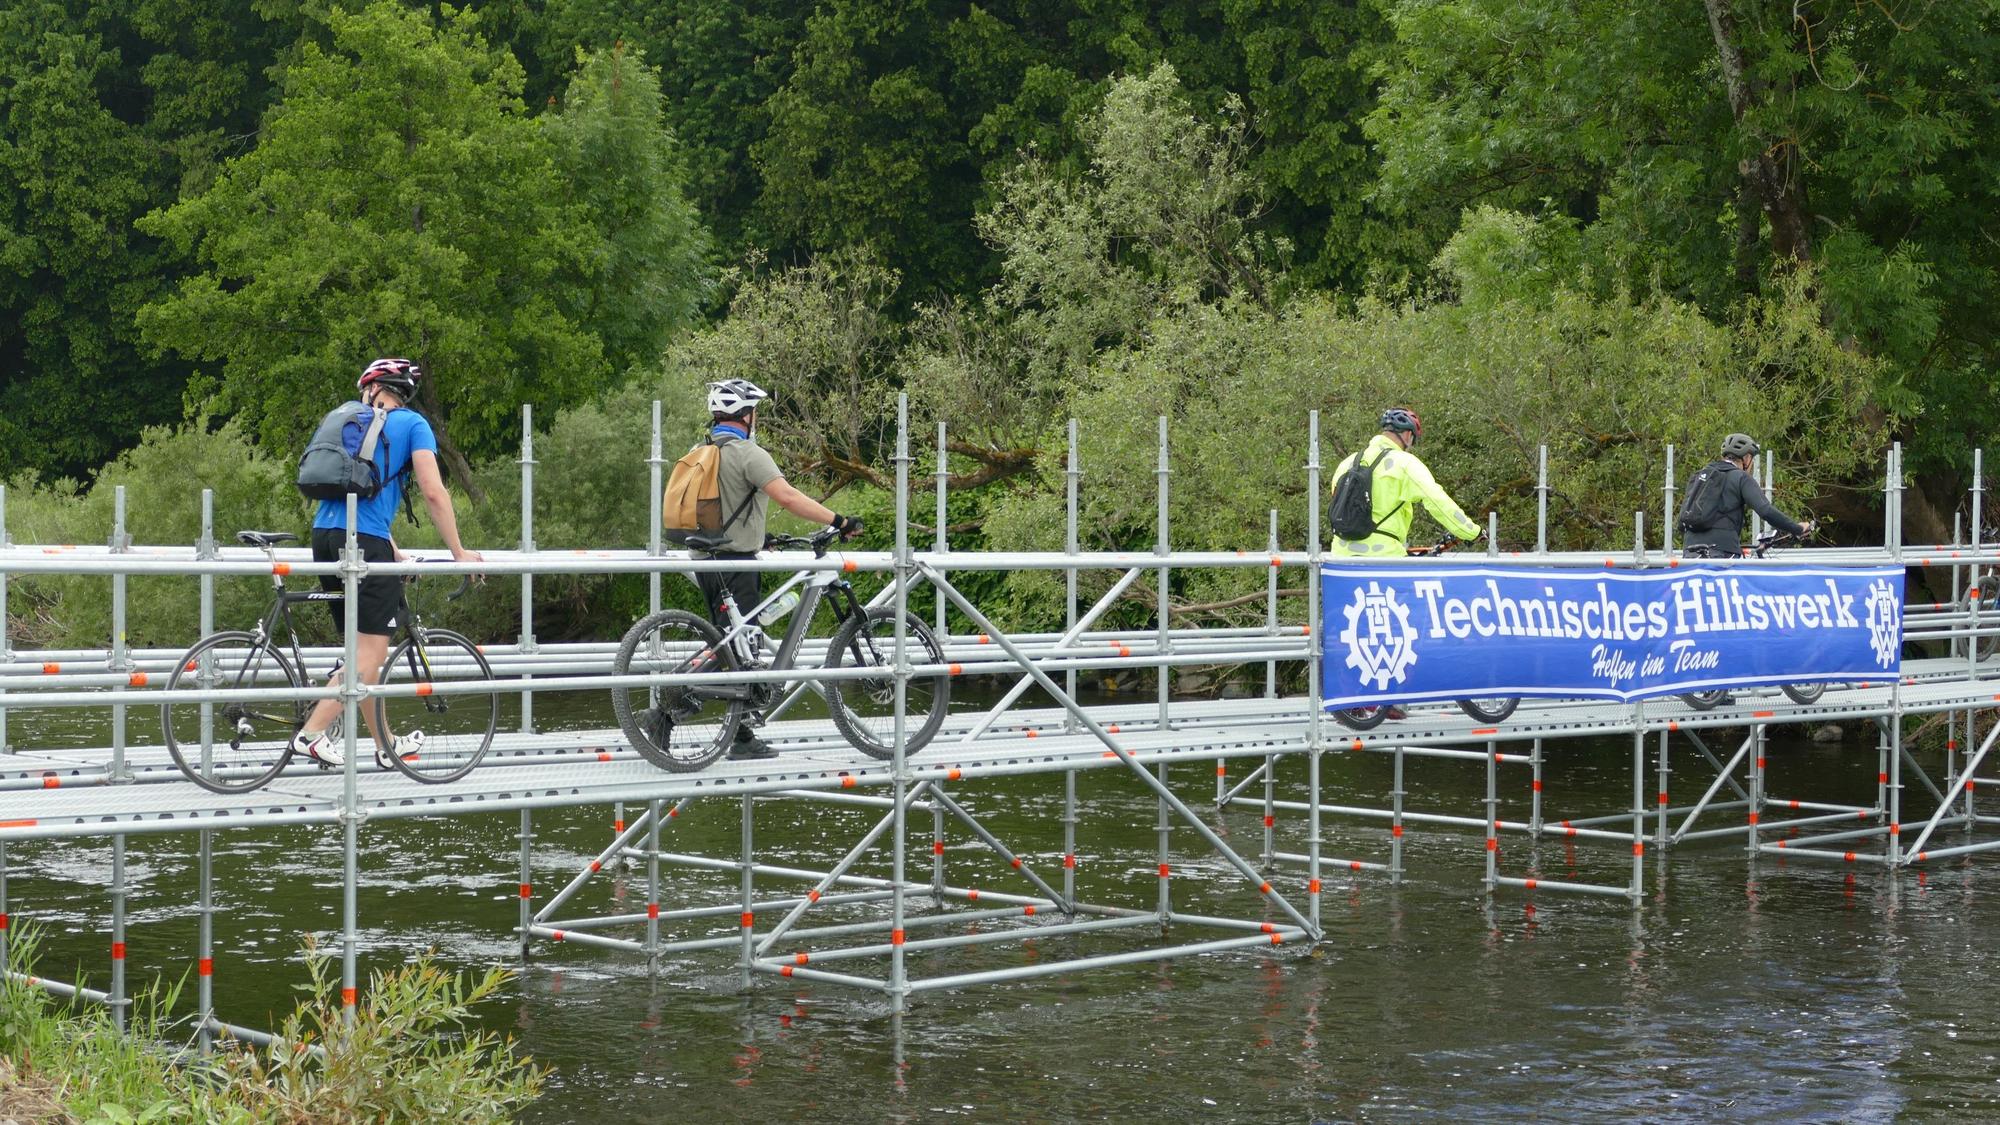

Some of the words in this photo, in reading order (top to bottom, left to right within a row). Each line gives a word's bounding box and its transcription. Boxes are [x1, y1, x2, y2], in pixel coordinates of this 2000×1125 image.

[1414, 579, 1668, 641] Technisches
[1671, 578, 1859, 634] Hilfswerk
[1592, 644, 1635, 687] Helfen
[1640, 649, 1665, 677] im
[1670, 639, 1719, 672] Team
